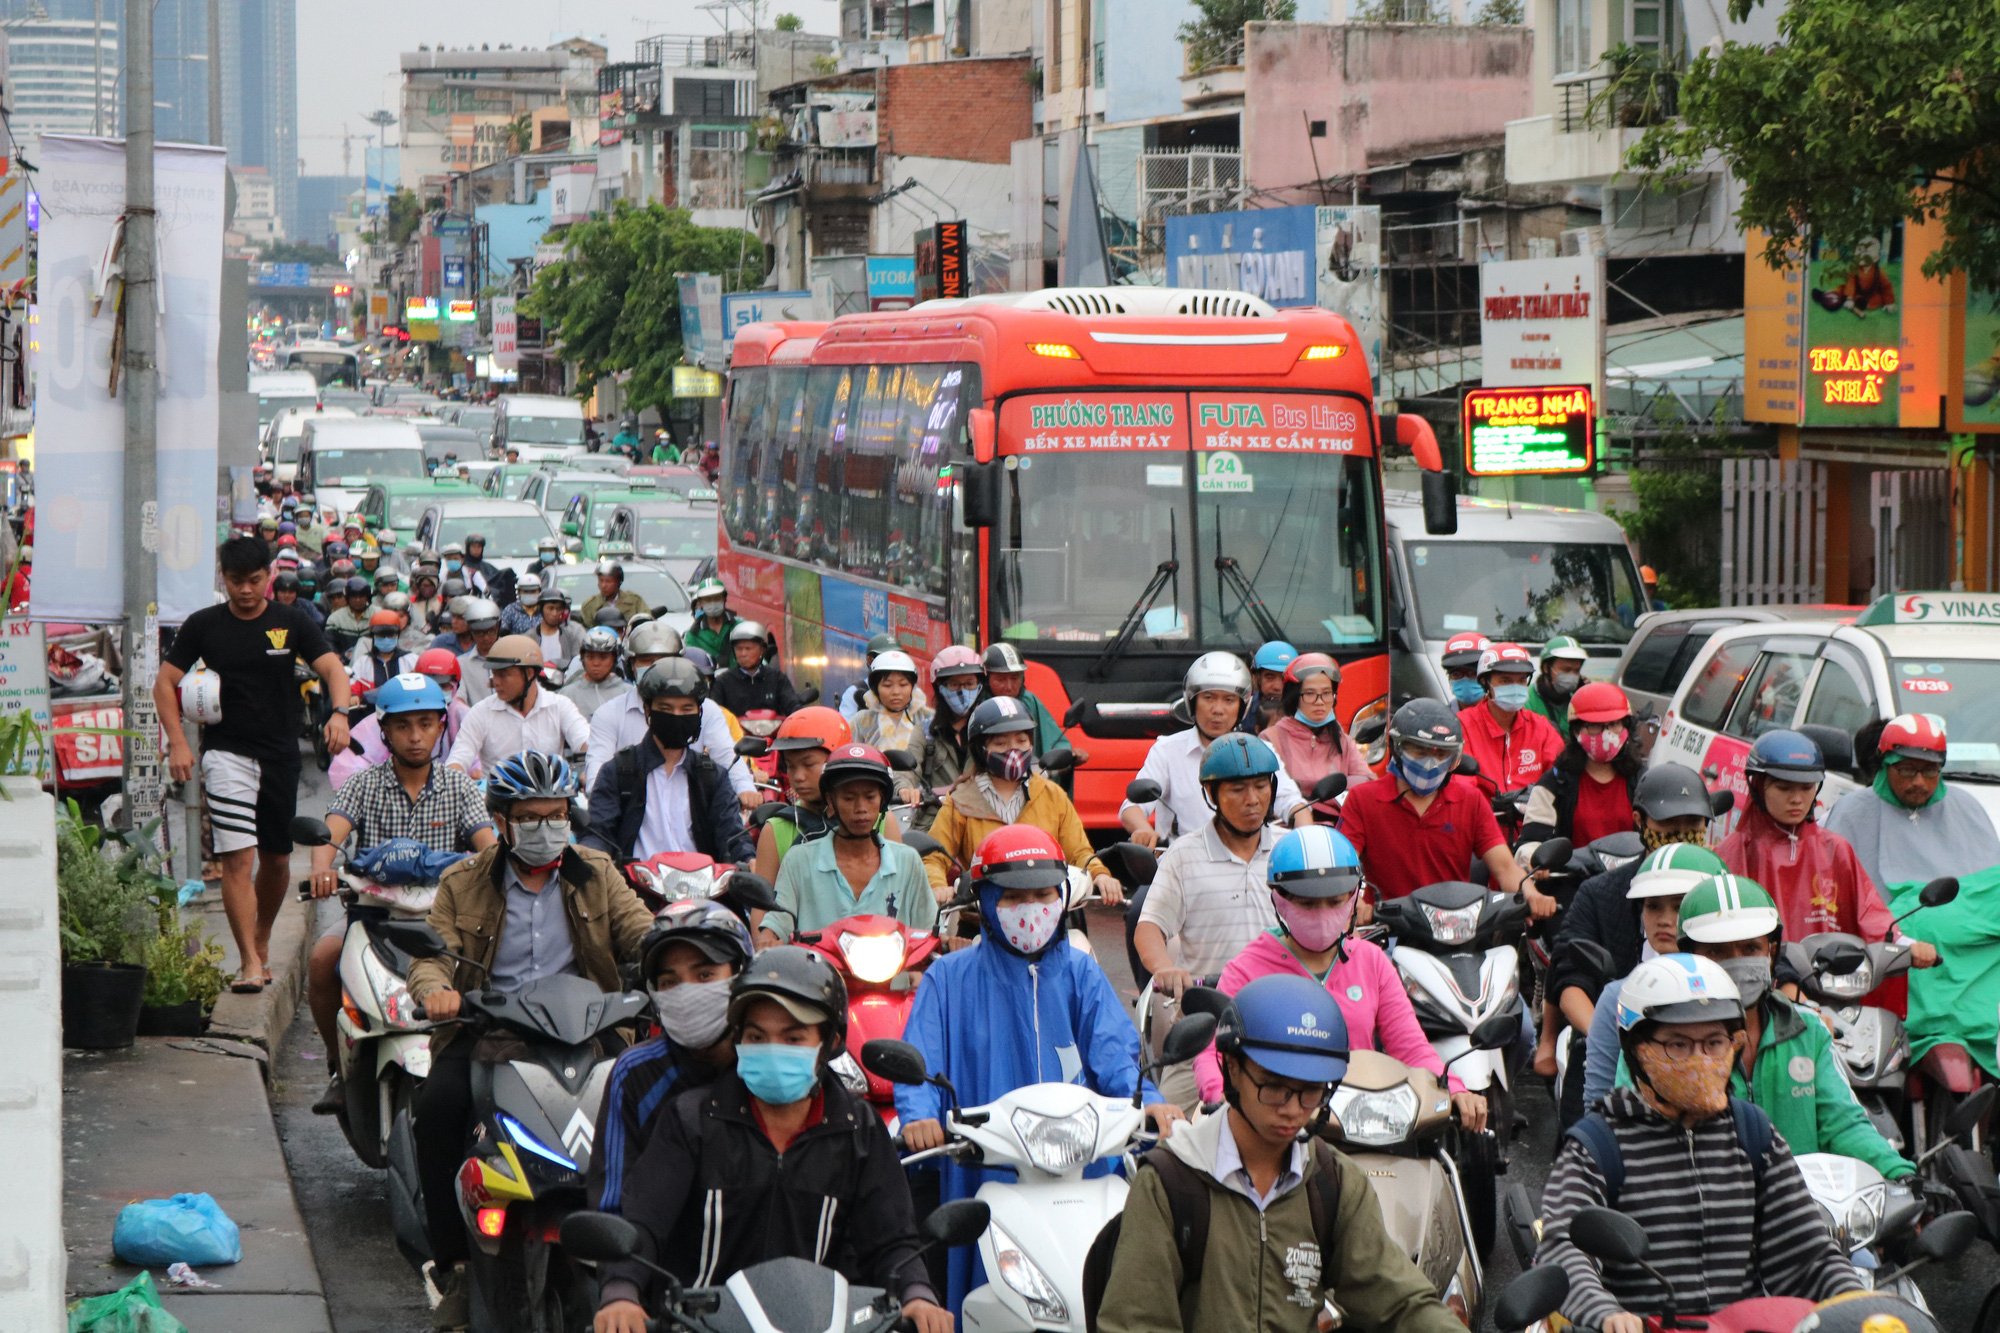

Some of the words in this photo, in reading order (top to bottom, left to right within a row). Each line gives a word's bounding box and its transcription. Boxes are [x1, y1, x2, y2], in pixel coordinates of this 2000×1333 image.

[498, 341, 514, 353] LAN
[1809, 348, 1899, 373] TRANG
[1824, 374, 1883, 404] NHÃ
[1472, 396, 1538, 417] TRANG
[1542, 391, 1586, 414] NHÃ
[1031, 399, 1107, 429] PHƯƠNG
[1110, 403, 1174, 427] TRANG
[1199, 403, 1266, 428] FUTA
[1273, 404, 1307, 429] Bus
[1311, 405, 1356, 432] Lines
[1024, 432, 1059, 450] BẾN
[1063, 436, 1086, 449] XE
[1090, 430, 1132, 448] MIỀN
[1135, 432, 1171, 448] TÂY
[1206, 431, 1243, 448] BẾN
[1247, 436, 1271, 448] XE
[1275, 431, 1314, 449] CẦN
[1318, 437, 1354, 451] THƠ
[1214, 458, 1236, 474] 24
[1202, 477, 1224, 489] CẦN
[1226, 479, 1248, 489] THƠ
[869, 592, 886, 620] SCB
[1941, 602, 2000, 618] VINAS
[10, 620, 33, 637] KÝ
[24, 686, 47, 697] CHÂU
[1905, 680, 1949, 692] 7936
[1005, 847, 1048, 860] HONDA
[1287, 1026, 1329, 1039] PIAGGIO
